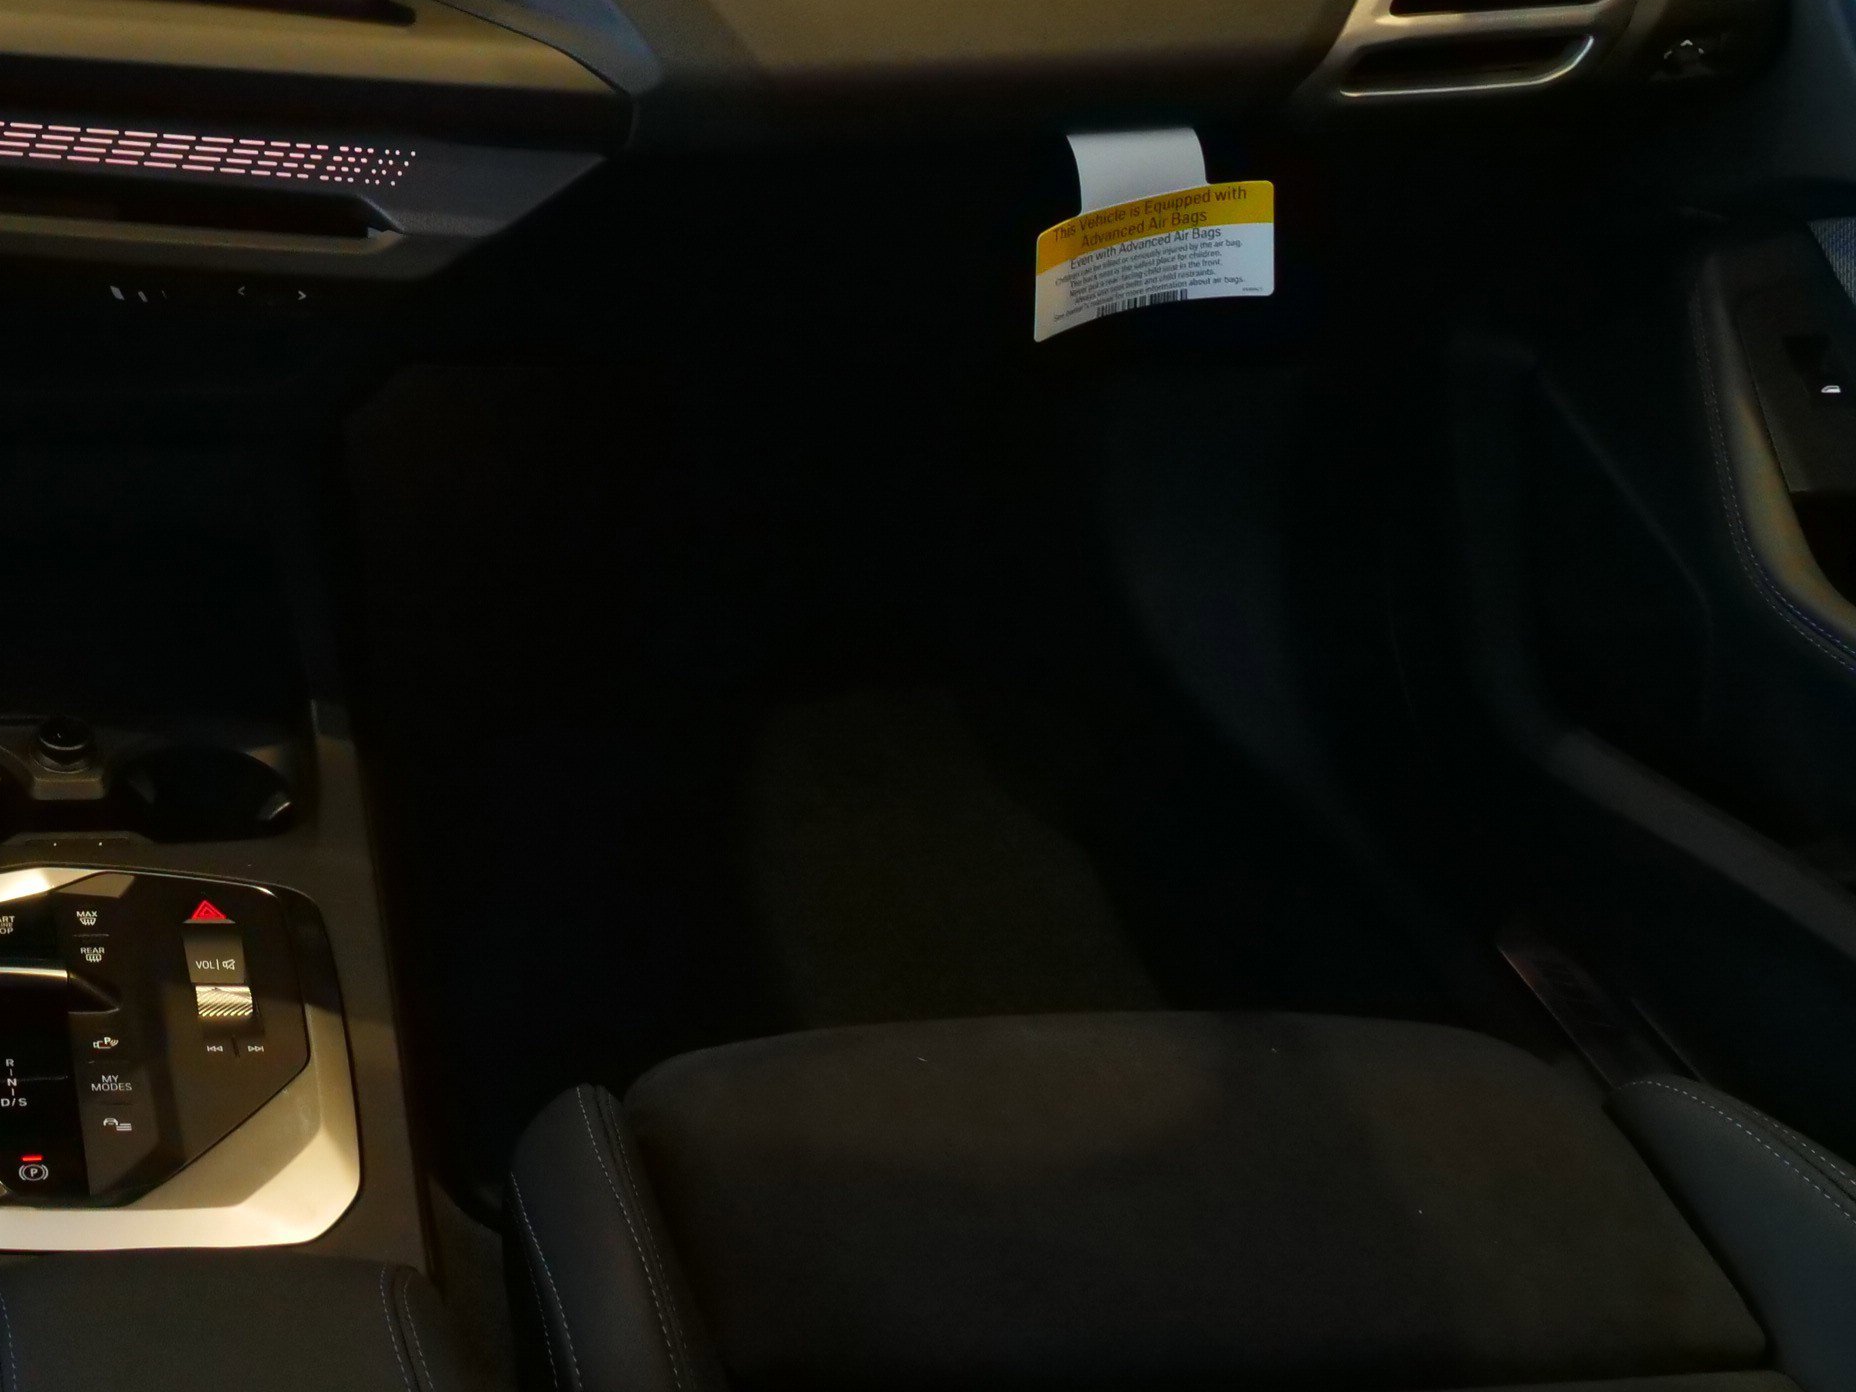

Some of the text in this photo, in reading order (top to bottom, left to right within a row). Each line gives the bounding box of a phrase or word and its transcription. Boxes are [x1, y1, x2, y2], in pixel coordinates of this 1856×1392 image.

[1052, 185, 1248, 243] This Vehicle is Equipped with
[1081, 209, 1208, 248] Advanced Air Bags
[1069, 226, 1223, 271] Even with Advanced Air Bags
[1188, 276, 1211, 287] about
[76, 910, 98, 918] MAX
[80, 946, 105, 954] REAR
[195, 958, 215, 969] VOL
[5, 1058, 15, 1067] R
[7, 1077, 18, 1087] N
[101, 1074, 119, 1084] MY
[91, 1082, 133, 1092] MODES
